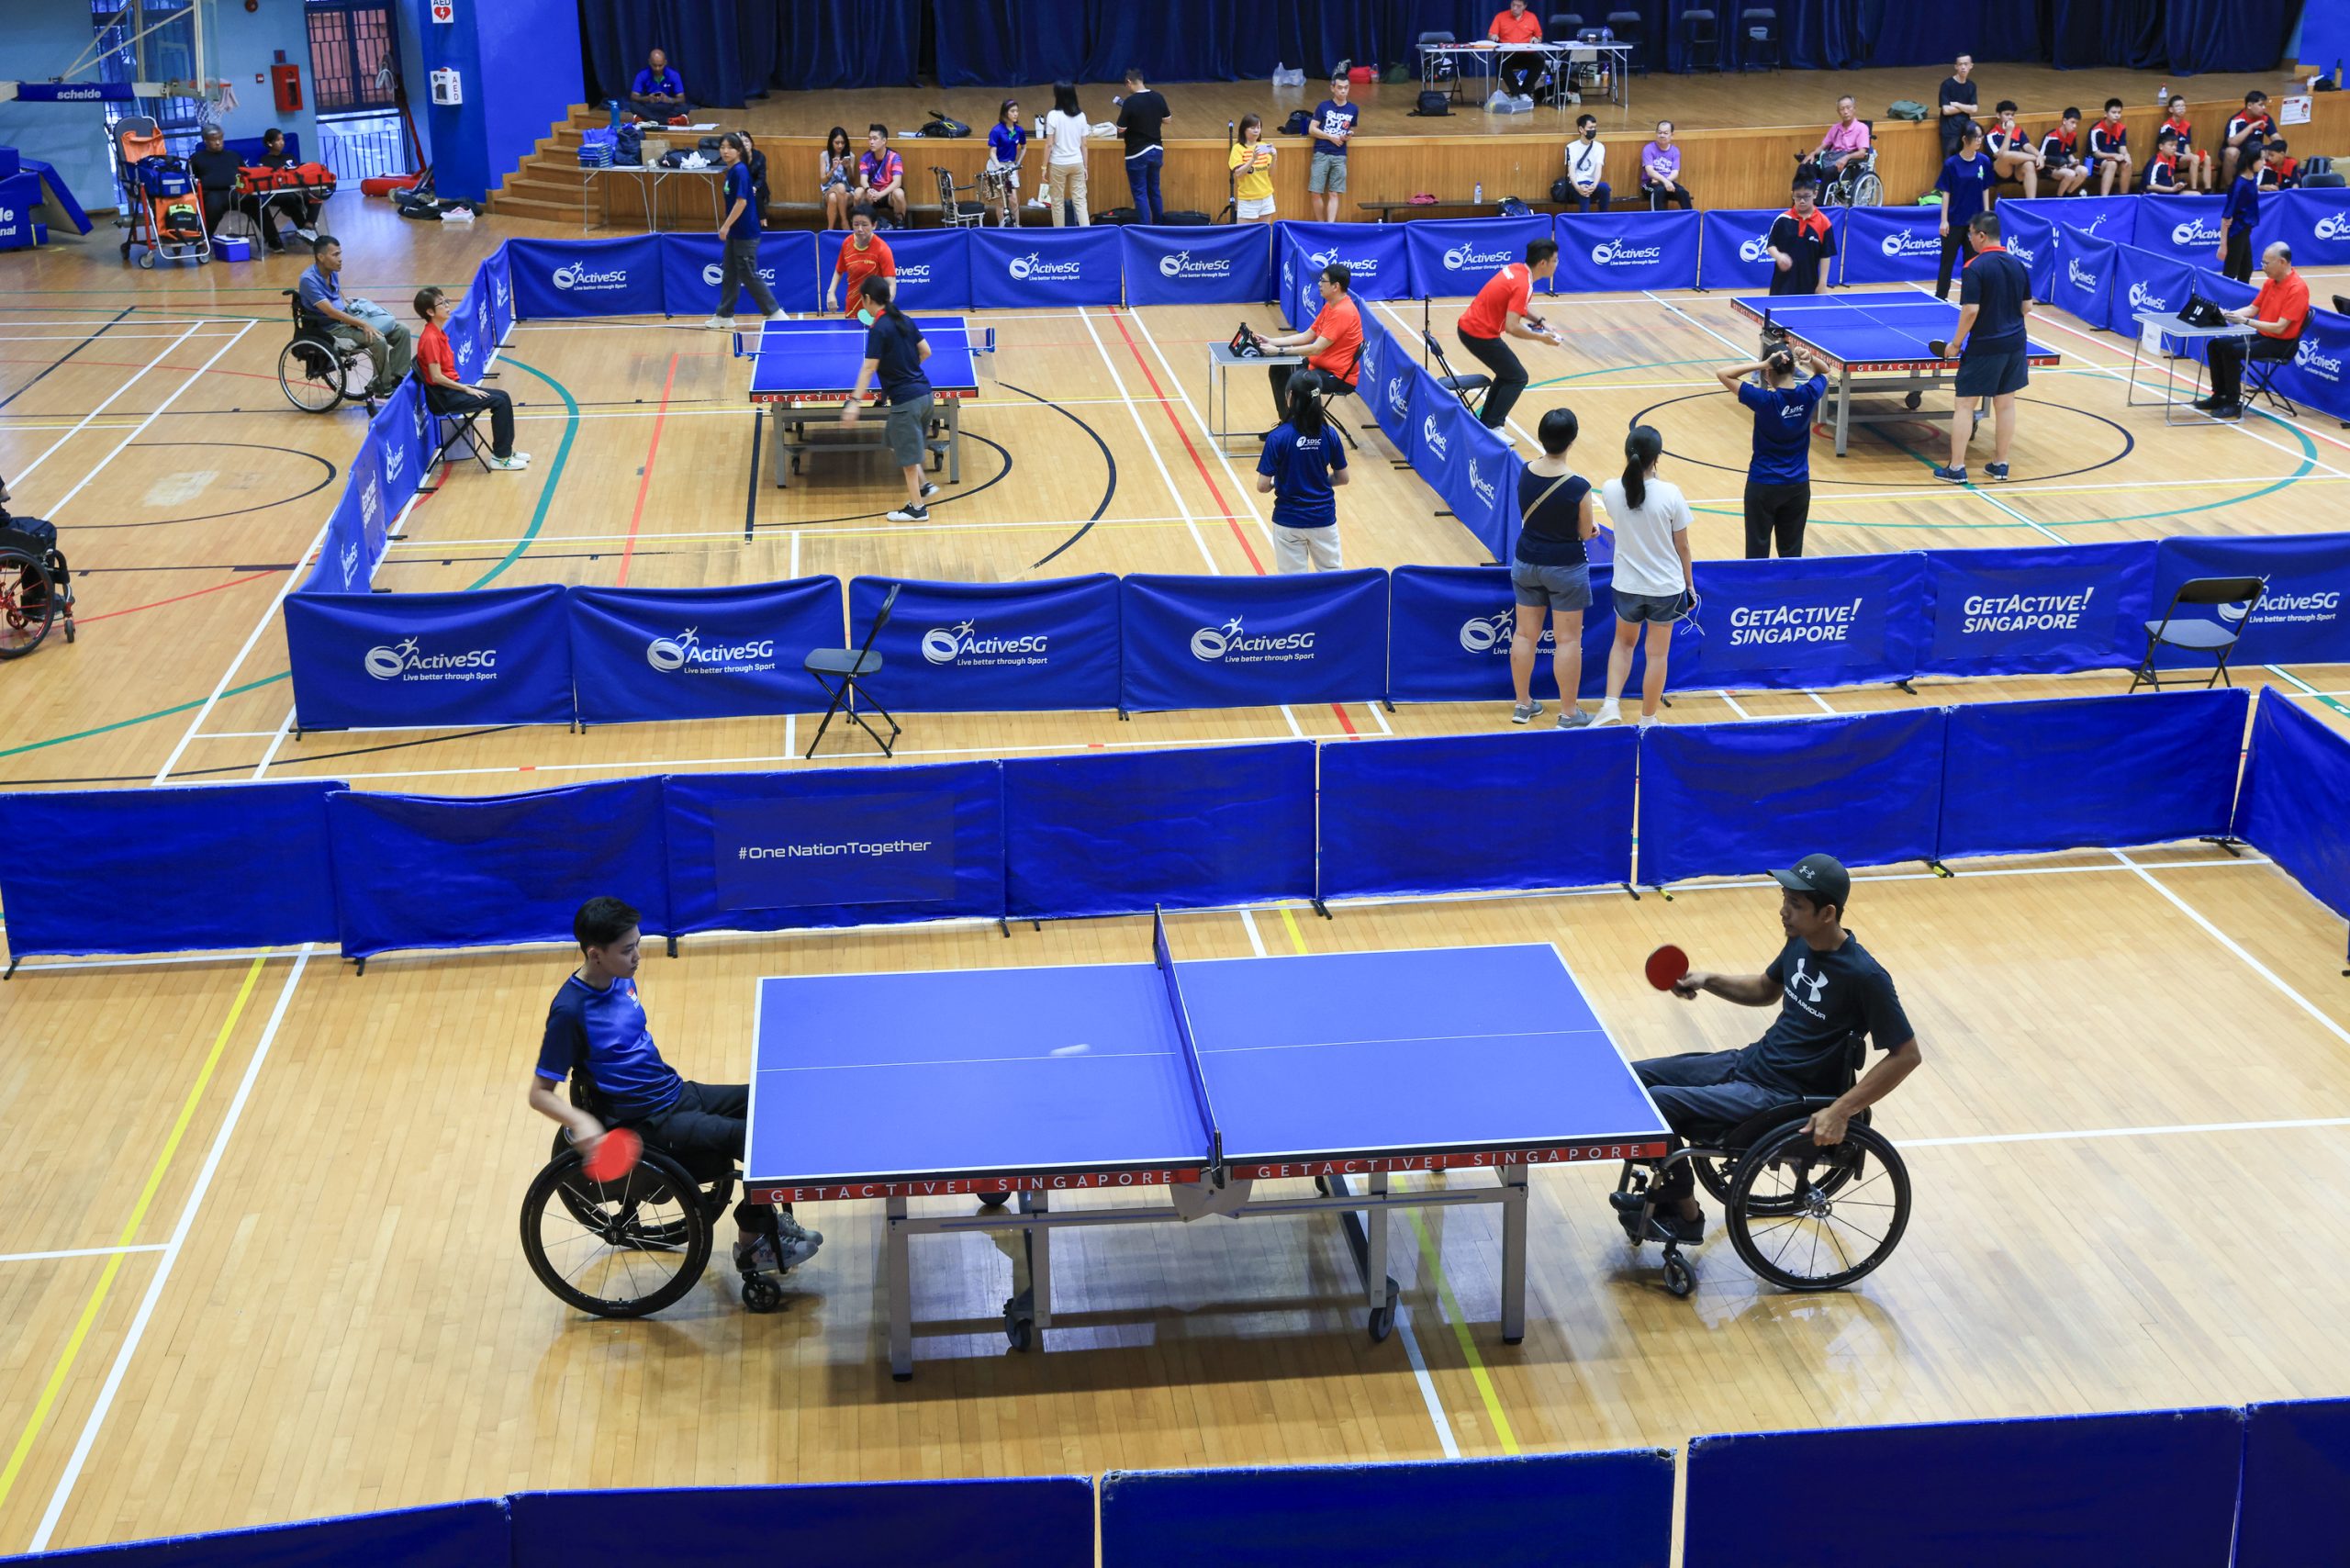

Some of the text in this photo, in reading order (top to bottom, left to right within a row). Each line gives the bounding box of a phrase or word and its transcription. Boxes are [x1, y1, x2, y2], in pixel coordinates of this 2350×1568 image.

[57, 89, 101, 100] schelde
[1463, 252, 1512, 263] ActiveSG
[1612, 247, 1661, 259] ActiveSG
[895, 265, 930, 275] tiveSG
[1030, 263, 1080, 274] ActiveSG
[1181, 260, 1230, 271] ActiveSG
[575, 271, 626, 284] ActiveSG
[762, 393, 851, 402] GETACTIVE
[2252, 592, 2341, 611] ActiveSG
[1962, 613, 2080, 634] SINGAPORE
[2288, 614, 2315, 622] through
[2316, 613, 2336, 622] Sport
[1729, 624, 1849, 646] SINGAPORE
[958, 636, 1048, 655] ActiveSG
[1227, 633, 1315, 652] ActiveSG
[686, 640, 774, 663] ActiveSG
[405, 650, 497, 670] ActiveSG
[997, 657, 1026, 666] through
[1027, 657, 1047, 666] Sport
[1264, 654, 1293, 663] through
[1293, 653, 1315, 661] Sport
[724, 664, 754, 673] through
[754, 663, 776, 671] Sport
[444, 672, 475, 681] through
[476, 672, 498, 680] Sport
[1797, 999, 1826, 1020] ARMOUR
[1258, 1145, 1640, 1178] GETACTIVE! SINGAPORE
[770, 1170, 1171, 1204] GETACTIVE! SINGAPORE
